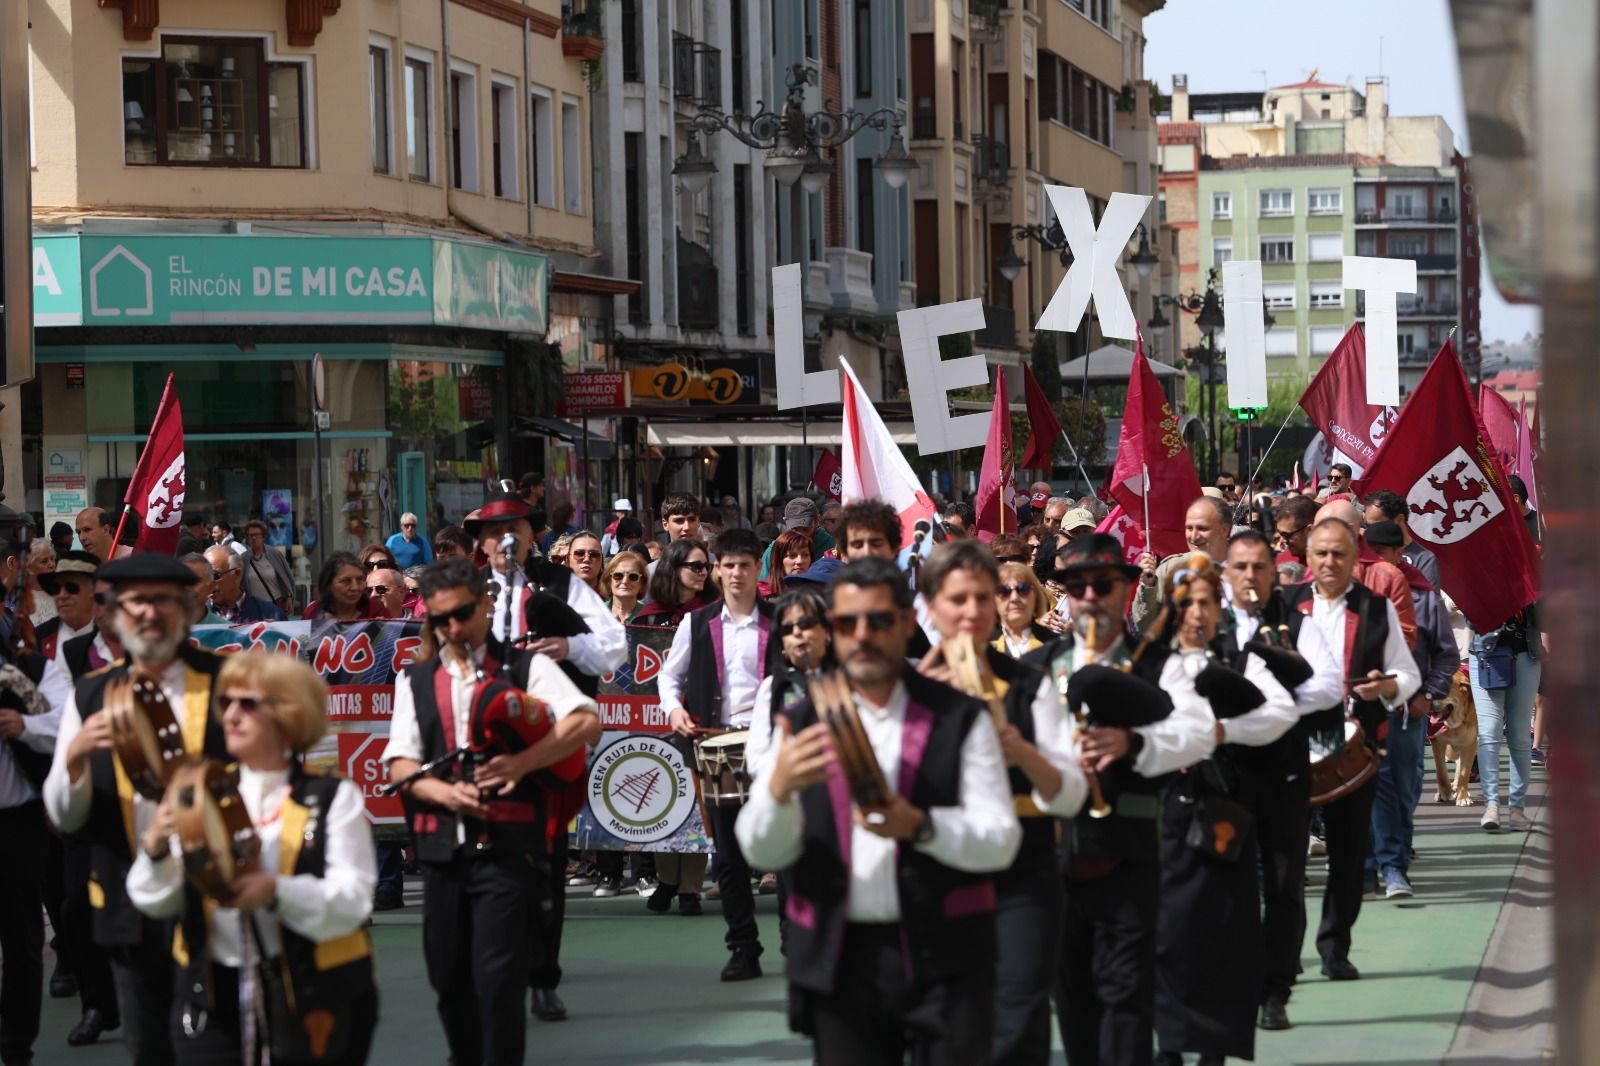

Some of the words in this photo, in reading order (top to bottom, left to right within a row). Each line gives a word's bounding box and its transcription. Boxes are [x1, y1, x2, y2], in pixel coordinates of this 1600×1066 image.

[169, 255, 193, 274] EL
[169, 273, 242, 298] RINCÓN
[252, 266, 293, 297] DE
[302, 266, 337, 297] MI
[344, 267, 428, 298] CASA
[593, 373, 623, 384] SECOS
[313, 631, 375, 677] NO
[371, 692, 394, 716] SOL
[363, 758, 391, 781] ST
[592, 765, 608, 798] TREN
[604, 743, 636, 765] RUTA
[639, 742, 657, 753] DE
[658, 747, 673, 763] LA
[671, 761, 687, 798] PLATA
[608, 818, 669, 836] Movimiento
